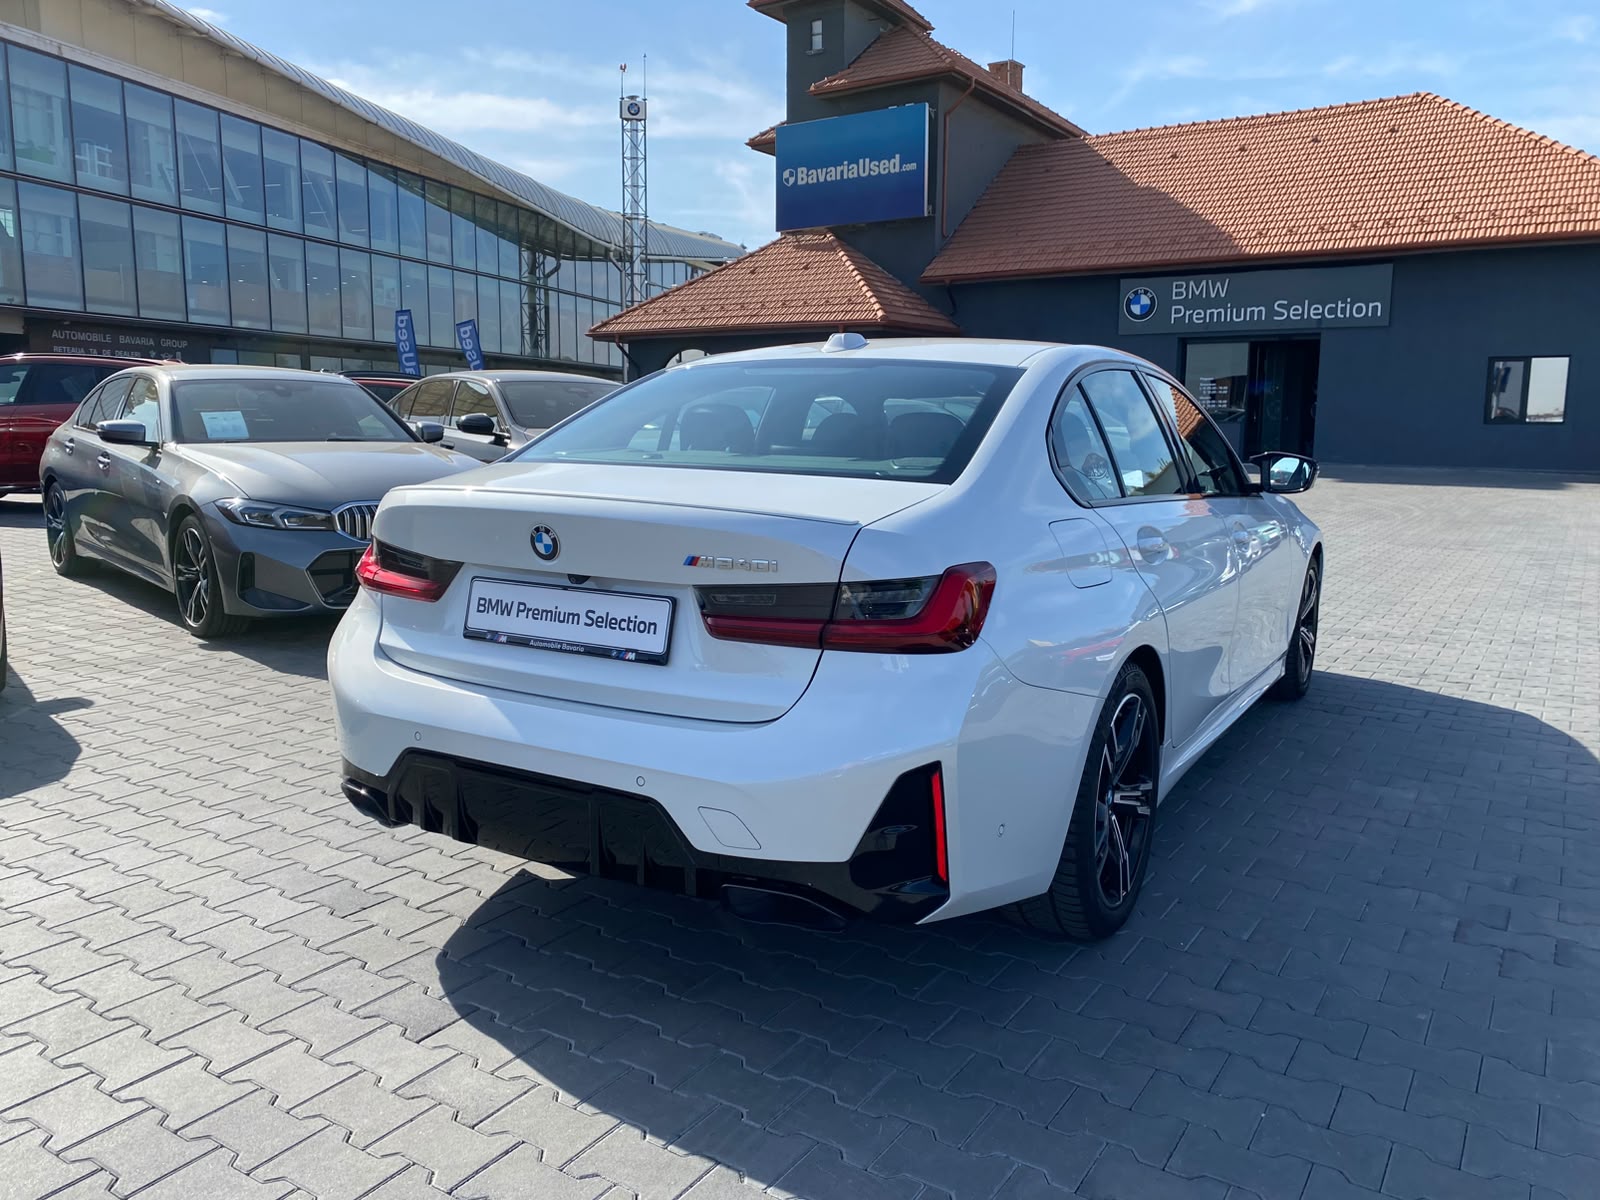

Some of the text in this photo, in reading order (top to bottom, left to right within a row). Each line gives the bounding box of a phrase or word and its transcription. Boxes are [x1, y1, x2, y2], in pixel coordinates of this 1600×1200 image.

[797, 154, 917, 185] BavariaUsed.com
[1172, 278, 1230, 300] BMW
[1170, 298, 1382, 324] Premium Selection
[51, 329, 188, 349] AUTOMOBILE BAVARIA GROUP
[476, 597, 658, 635] BMW Premium Selection
[529, 639, 585, 652] Automobile Bavaria
